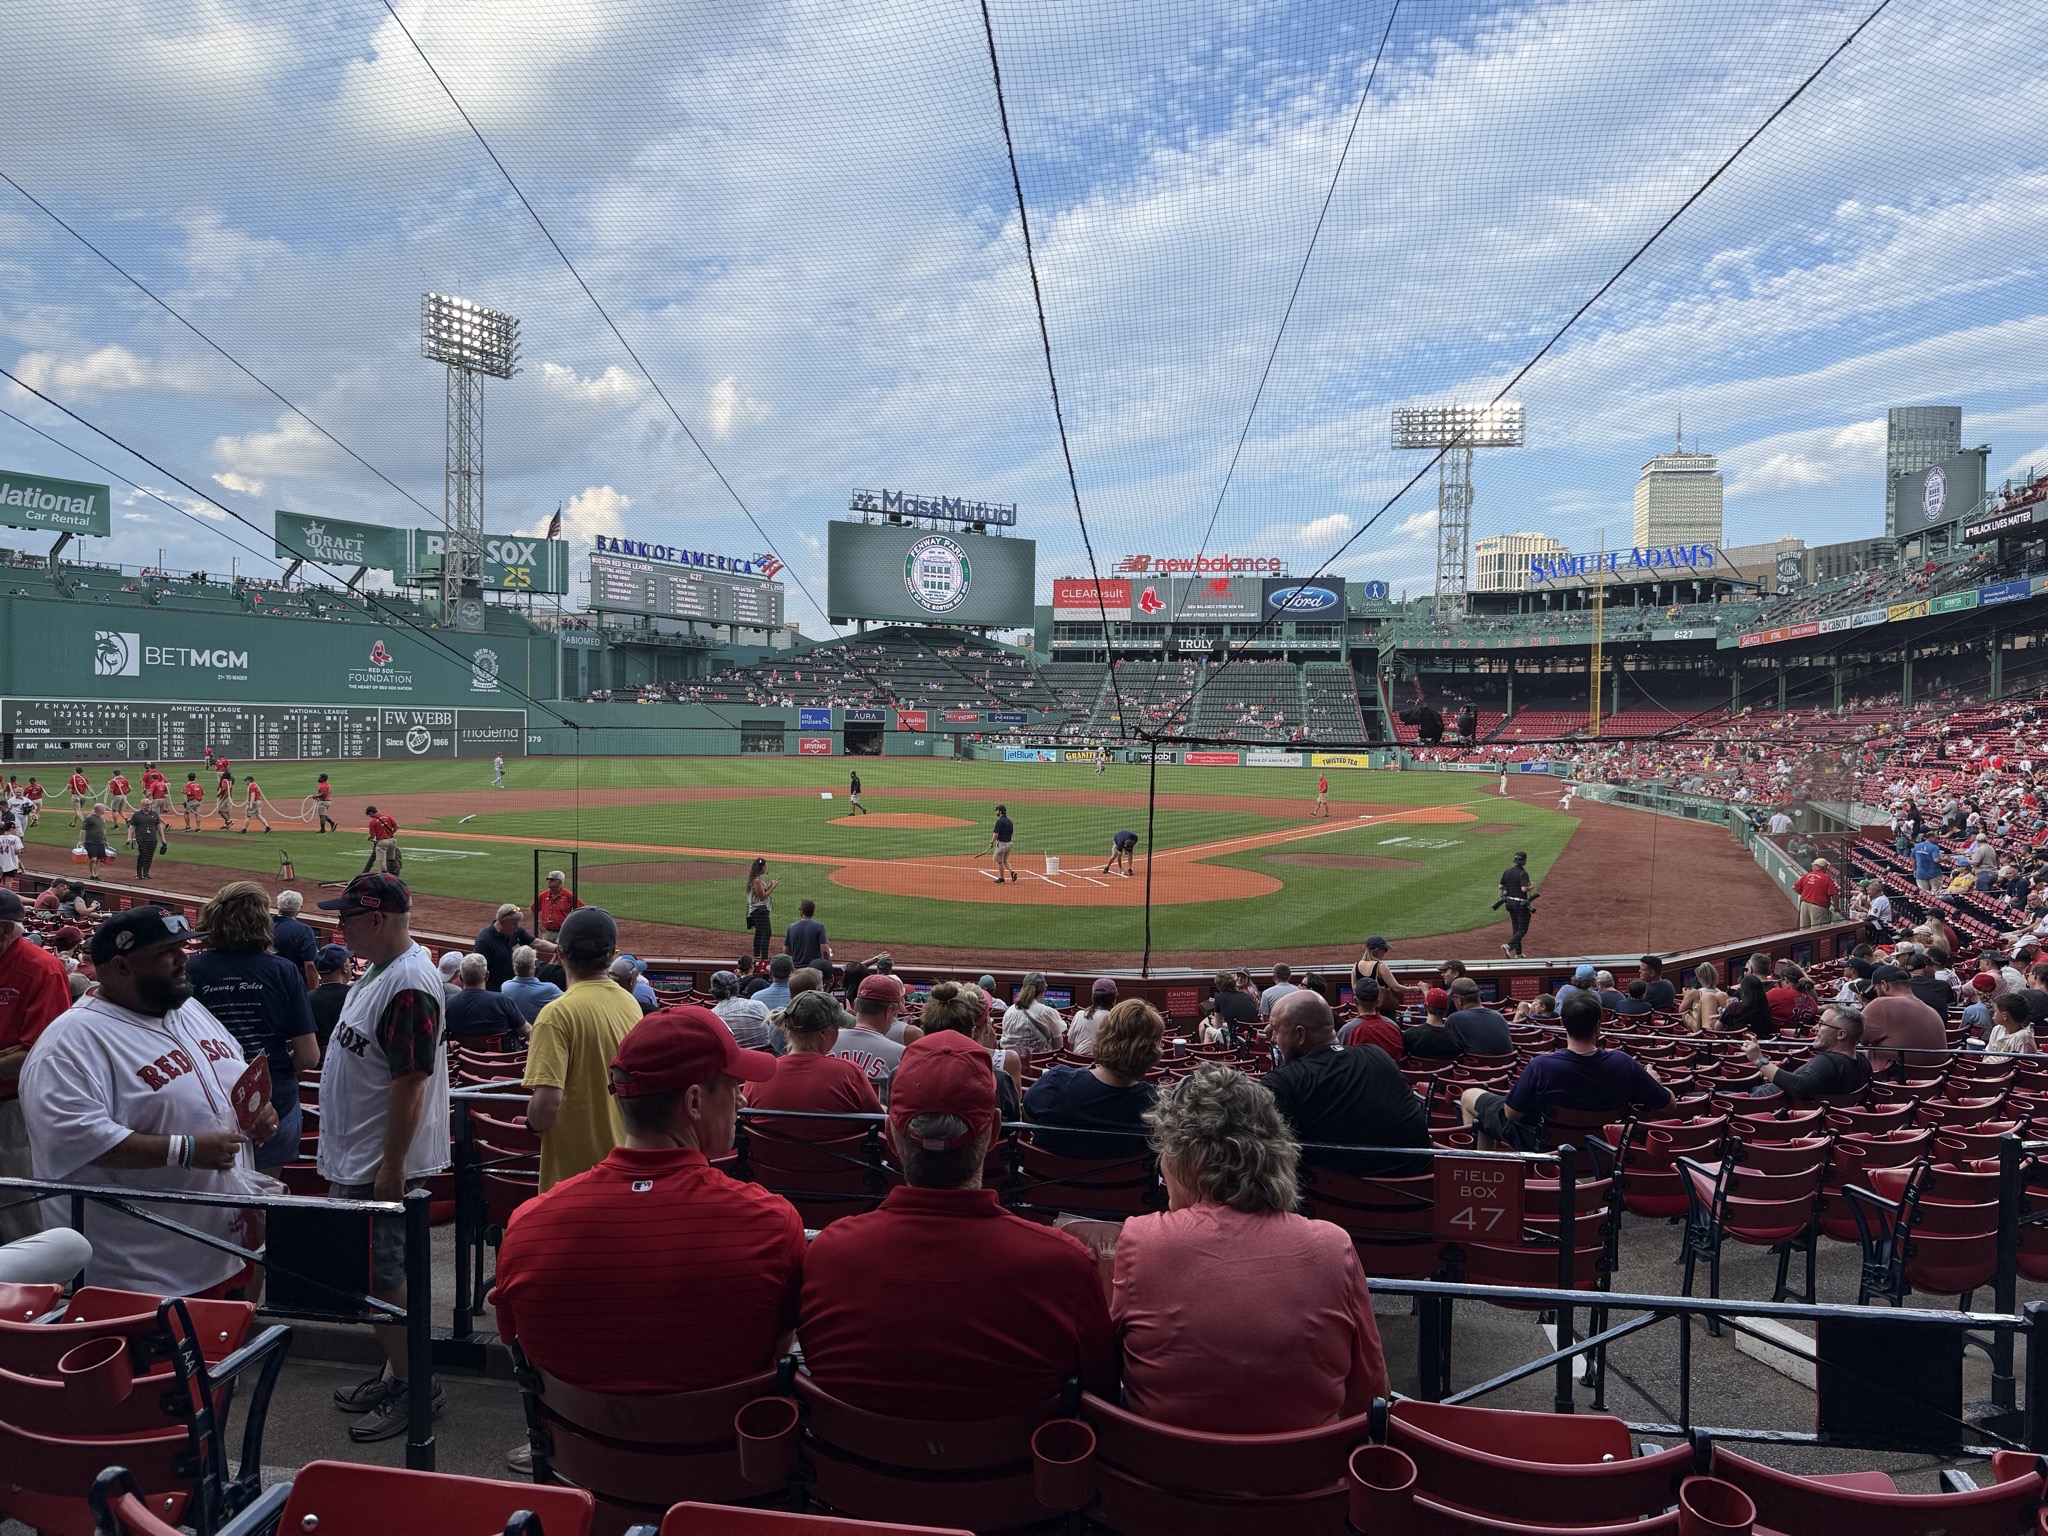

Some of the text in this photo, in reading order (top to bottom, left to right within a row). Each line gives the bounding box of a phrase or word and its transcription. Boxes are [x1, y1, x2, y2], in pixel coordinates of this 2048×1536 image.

[883, 488, 1017, 526] MassMutual
[25, 510, 90, 526] Car Rental
[1974, 512, 2031, 536] BLACK LIVES MATTER
[306, 533, 364, 551] DRAFT
[910, 537, 965, 561] FENWAY PARK
[314, 546, 363, 562] KINGS
[486, 540, 537, 566] SOX
[597, 534, 752, 574] BANK OF AMERICA
[1777, 551, 1802, 561] BOSTON
[1530, 543, 1714, 584] SAMUEL ADAMS
[503, 567, 531, 587] 25
[1777, 572, 1802, 582] ACADEMY
[1061, 589, 1124, 598] CLEAResult
[1283, 591, 1323, 608] Ford
[931, 602, 954, 611] BOSTON
[565, 636, 600, 646] ABIOMED
[1674, 631, 1693, 639] 6:27
[1178, 640, 1213, 649] TRULY
[145, 647, 248, 668] BETMGM
[349, 673, 412, 683] FOUNDATION
[384, 711, 452, 725] F.W. WEBB
[463, 726, 518, 738] moderna
[1007, 751, 1034, 760] jetBlue
[1065, 751, 1097, 760] GRANITE
[1140, 752, 1170, 760] wasabi
[1322, 757, 1347, 765] TWISTED
[202, 982, 263, 995] Fenway Rules
[136, 1049, 193, 1092] RED
[1453, 1169, 1505, 1183] FIELD
[1460, 1186, 1498, 1199] BOX
[1906, 1188, 1916, 1199] M
[1449, 1206, 1506, 1231] 47
[182, 1349, 196, 1373] AA
